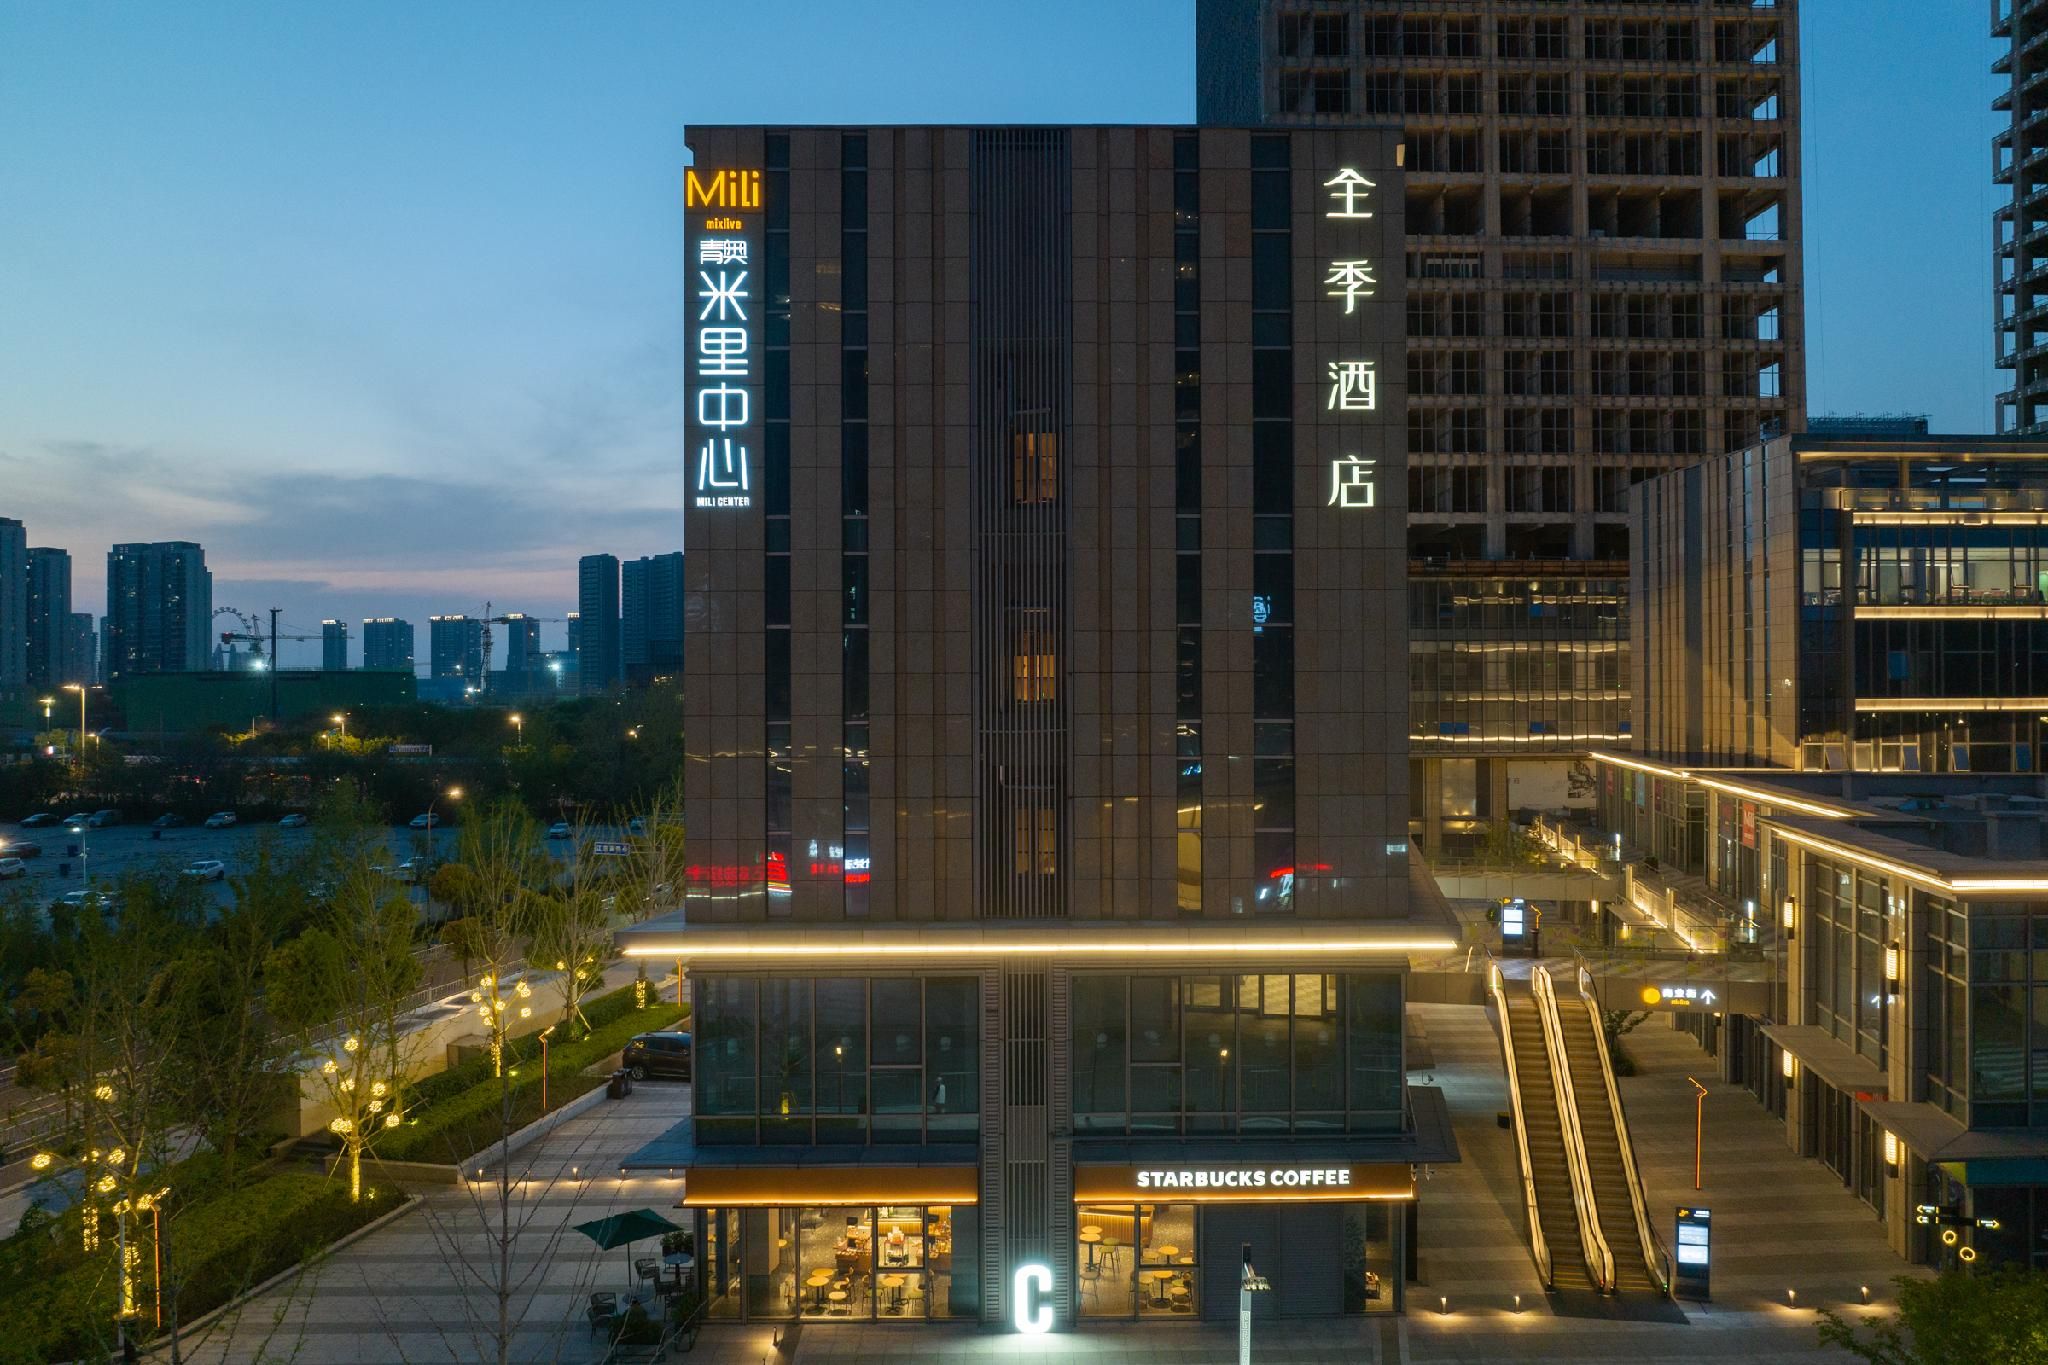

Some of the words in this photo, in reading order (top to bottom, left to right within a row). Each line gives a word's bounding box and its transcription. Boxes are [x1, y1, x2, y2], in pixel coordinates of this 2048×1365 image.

[706, 217, 742, 230] mixlive
[1323, 167, 1377, 508] 全季酒店
[698, 270, 749, 490] 米里中心
[696, 496, 716, 507] MILI
[717, 496, 750, 507] CENTER
[1137, 1170, 1266, 1187] STARBUCKS
[1270, 1169, 1350, 1186] COFFEE
[1014, 1264, 1053, 1333] C
